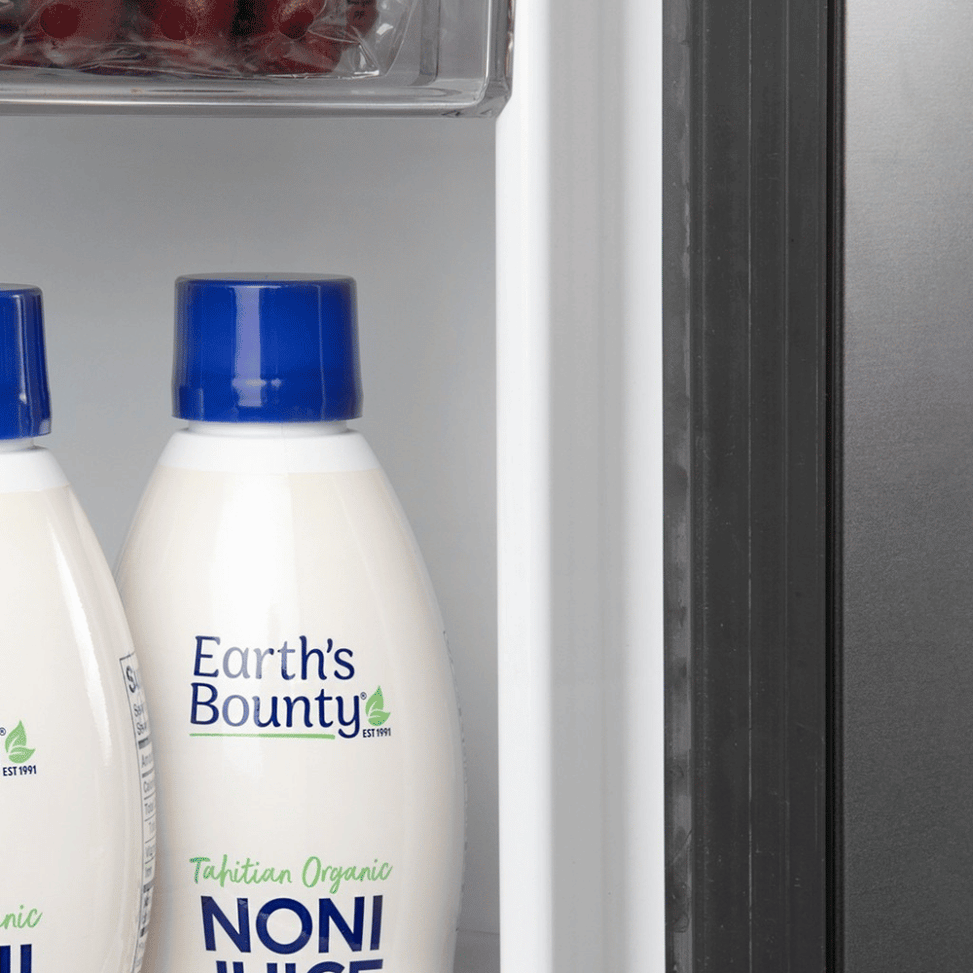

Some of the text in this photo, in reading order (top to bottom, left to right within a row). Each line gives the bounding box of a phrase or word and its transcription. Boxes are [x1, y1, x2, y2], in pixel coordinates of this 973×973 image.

[193, 635, 355, 681] Earth's
[376, 727, 391, 738] 1991
[3, 765, 37, 777] EST 1991
[190, 854, 393, 894] Tahitian Organic
[201, 895, 384, 955] NONI
